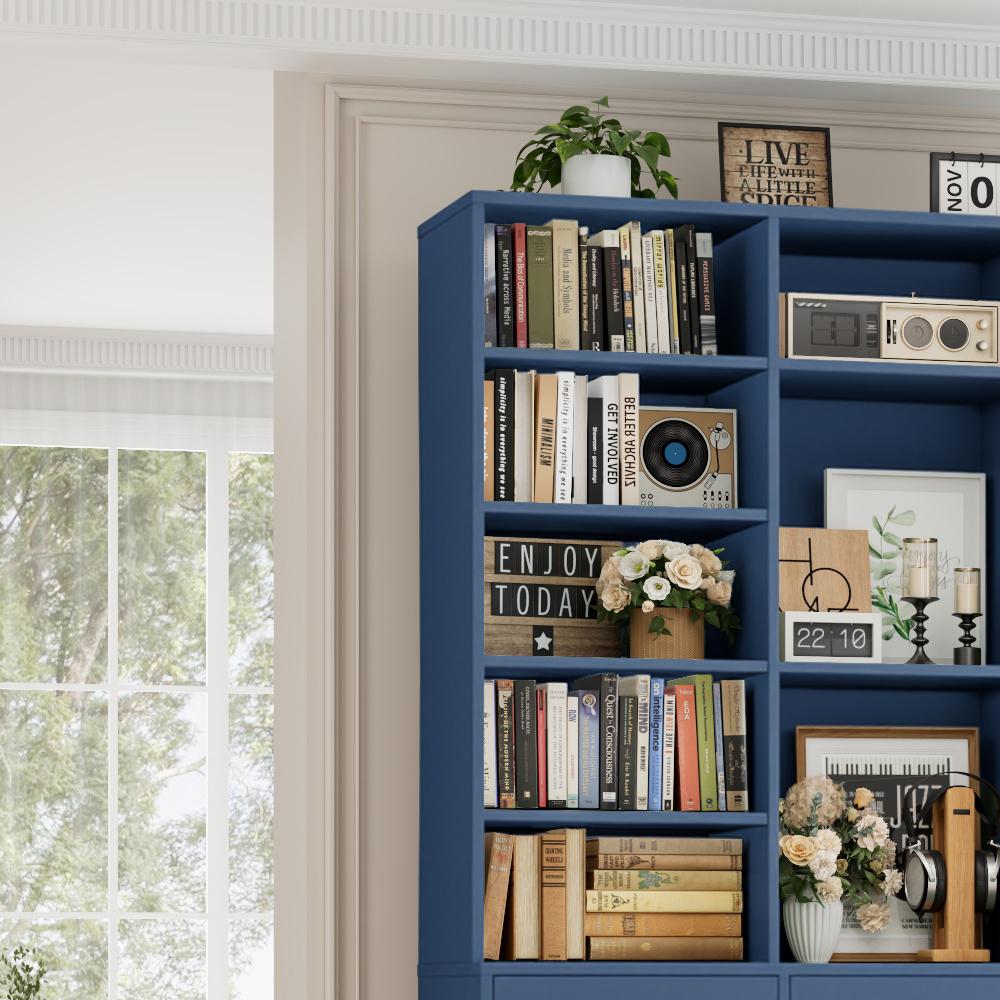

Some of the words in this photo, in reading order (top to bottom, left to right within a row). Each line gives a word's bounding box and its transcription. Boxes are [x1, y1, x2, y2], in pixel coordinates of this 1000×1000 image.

[745, 140, 810, 165] LIVE
[740, 178, 752, 191] A
[757, 179, 815, 194] LITTLE
[778, 169, 815, 178] WITH
[947, 169, 962, 211] NOV
[563, 248, 572, 268] Media
[563, 271, 572, 282] and
[561, 286, 573, 313] Symbols
[607, 404, 618, 424] GET
[498, 434, 506, 472] everything
[540, 418, 553, 466] MINIMALISM
[608, 428, 617, 485] INVOLVED
[499, 475, 505, 484] we
[500, 543, 598, 577] ENJOY
[495, 585, 594, 618] TODAY
[797, 628, 825, 648] 22
[840, 629, 866, 649] 10
[653, 683, 660, 694] on
[605, 694, 615, 718] Quest
[639, 703, 648, 733] MIND
[651, 696, 662, 751] intelligence
[605, 725, 615, 783] Consciousness
